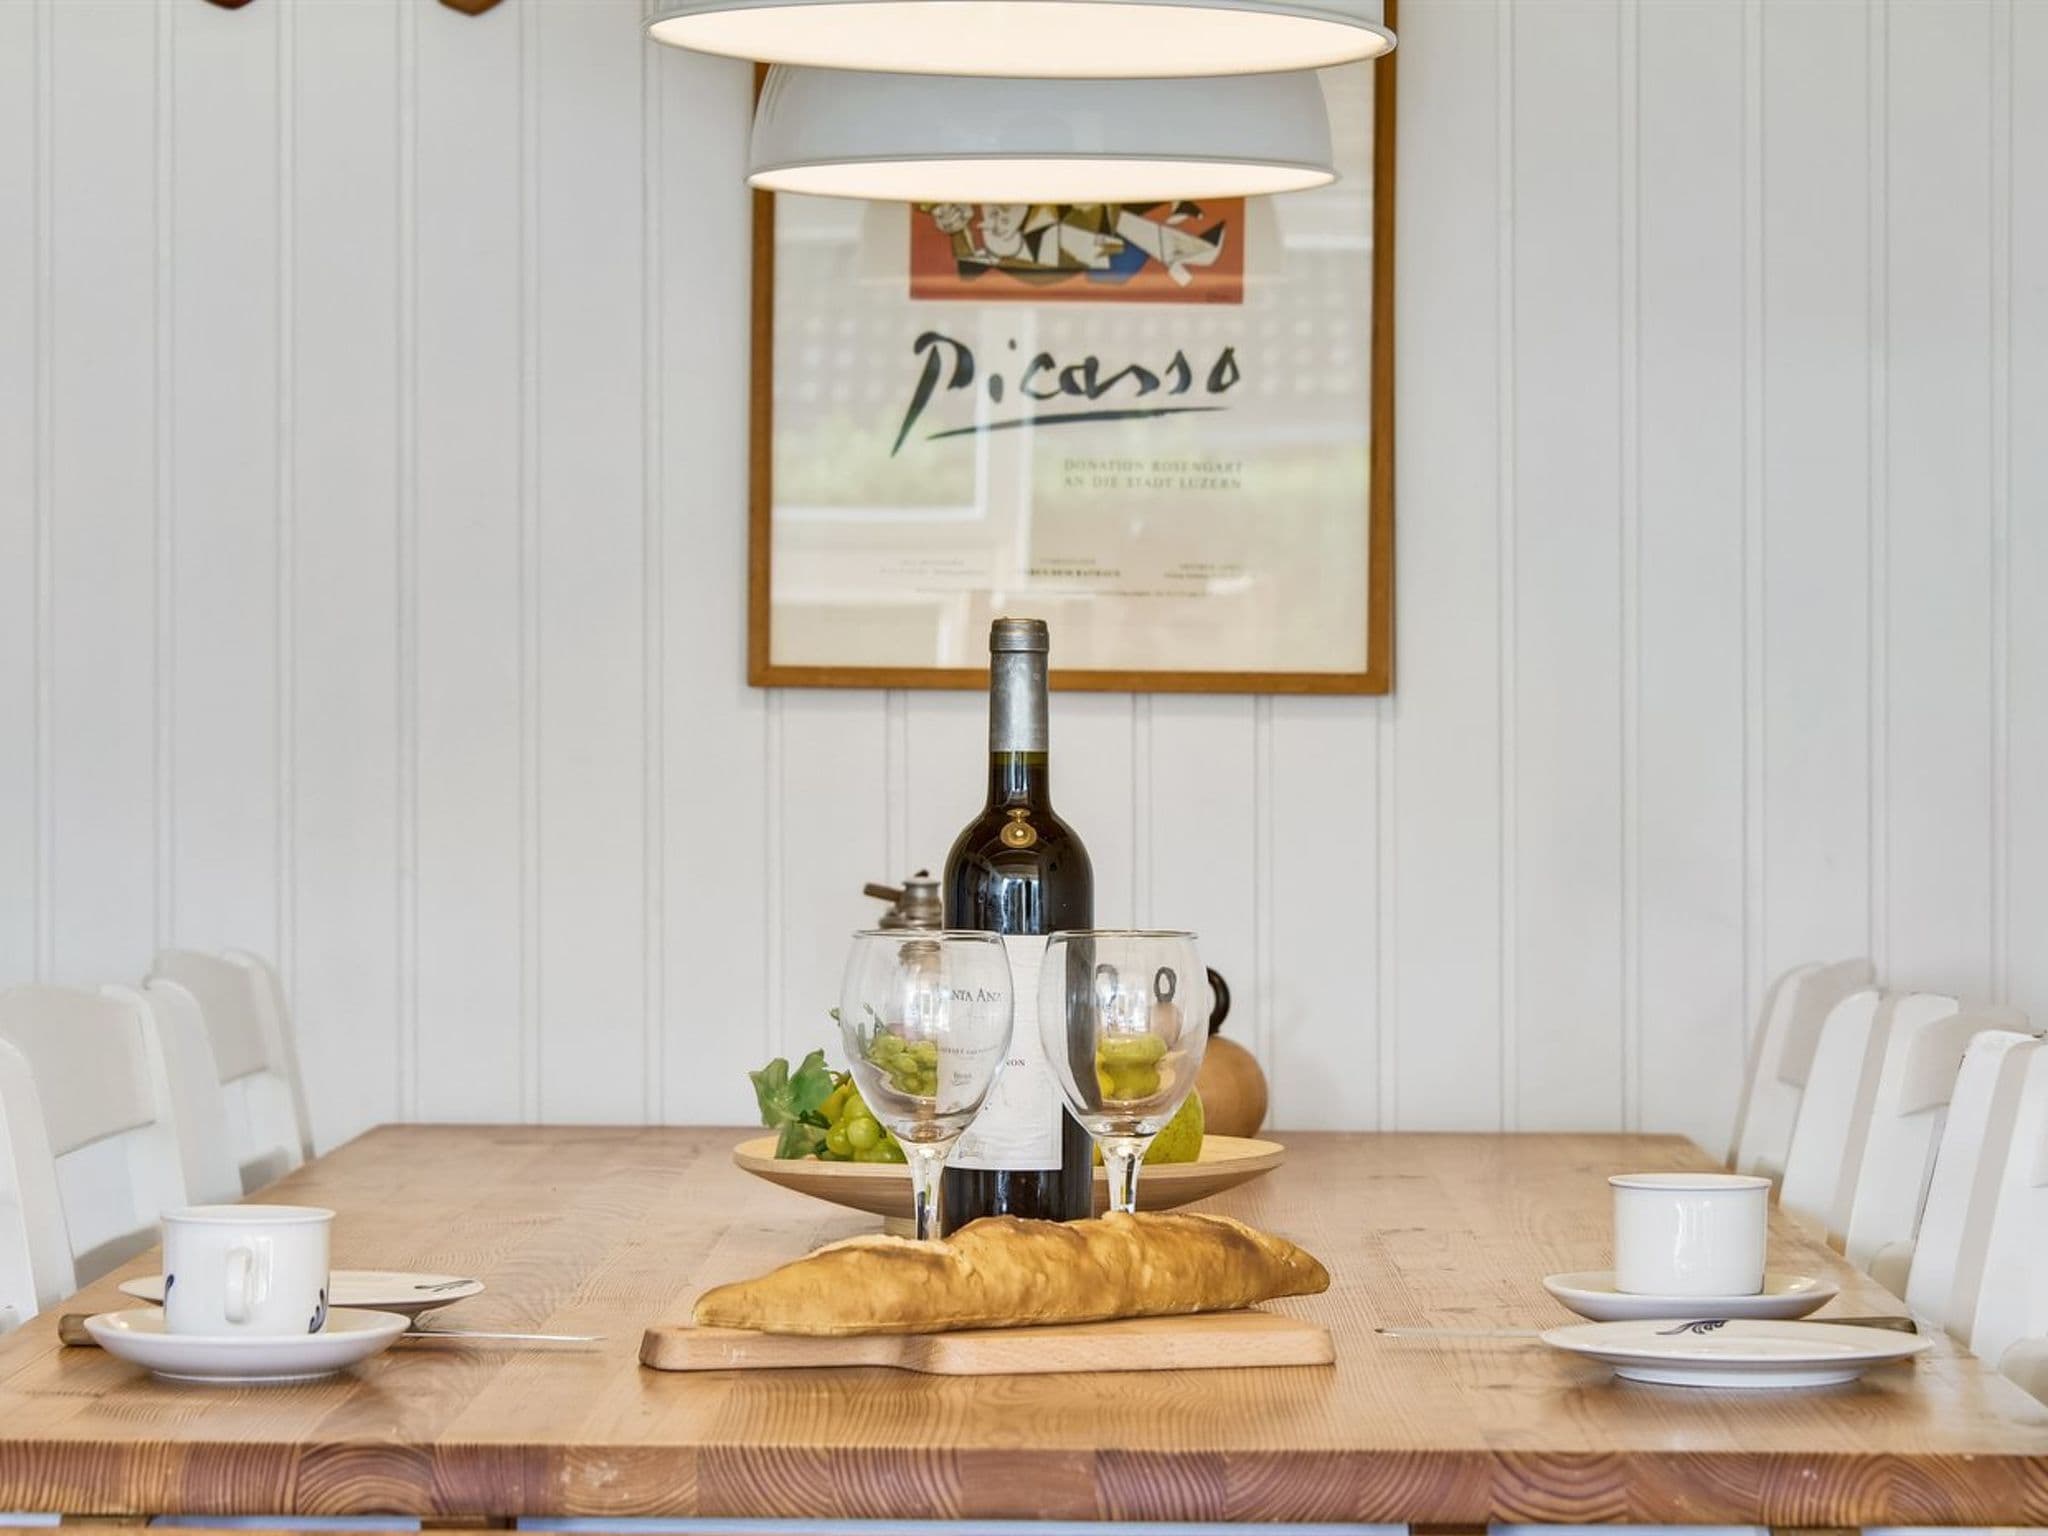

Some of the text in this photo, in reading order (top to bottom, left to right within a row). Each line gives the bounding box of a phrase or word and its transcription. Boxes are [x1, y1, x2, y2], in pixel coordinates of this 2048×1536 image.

[891, 331, 1240, 456] Picasso
[1063, 458, 1243, 474] DONATION ROSENGART
[1063, 476, 1242, 490] AN DIE STADT LUZERN
[950, 988, 974, 1002] NTA
